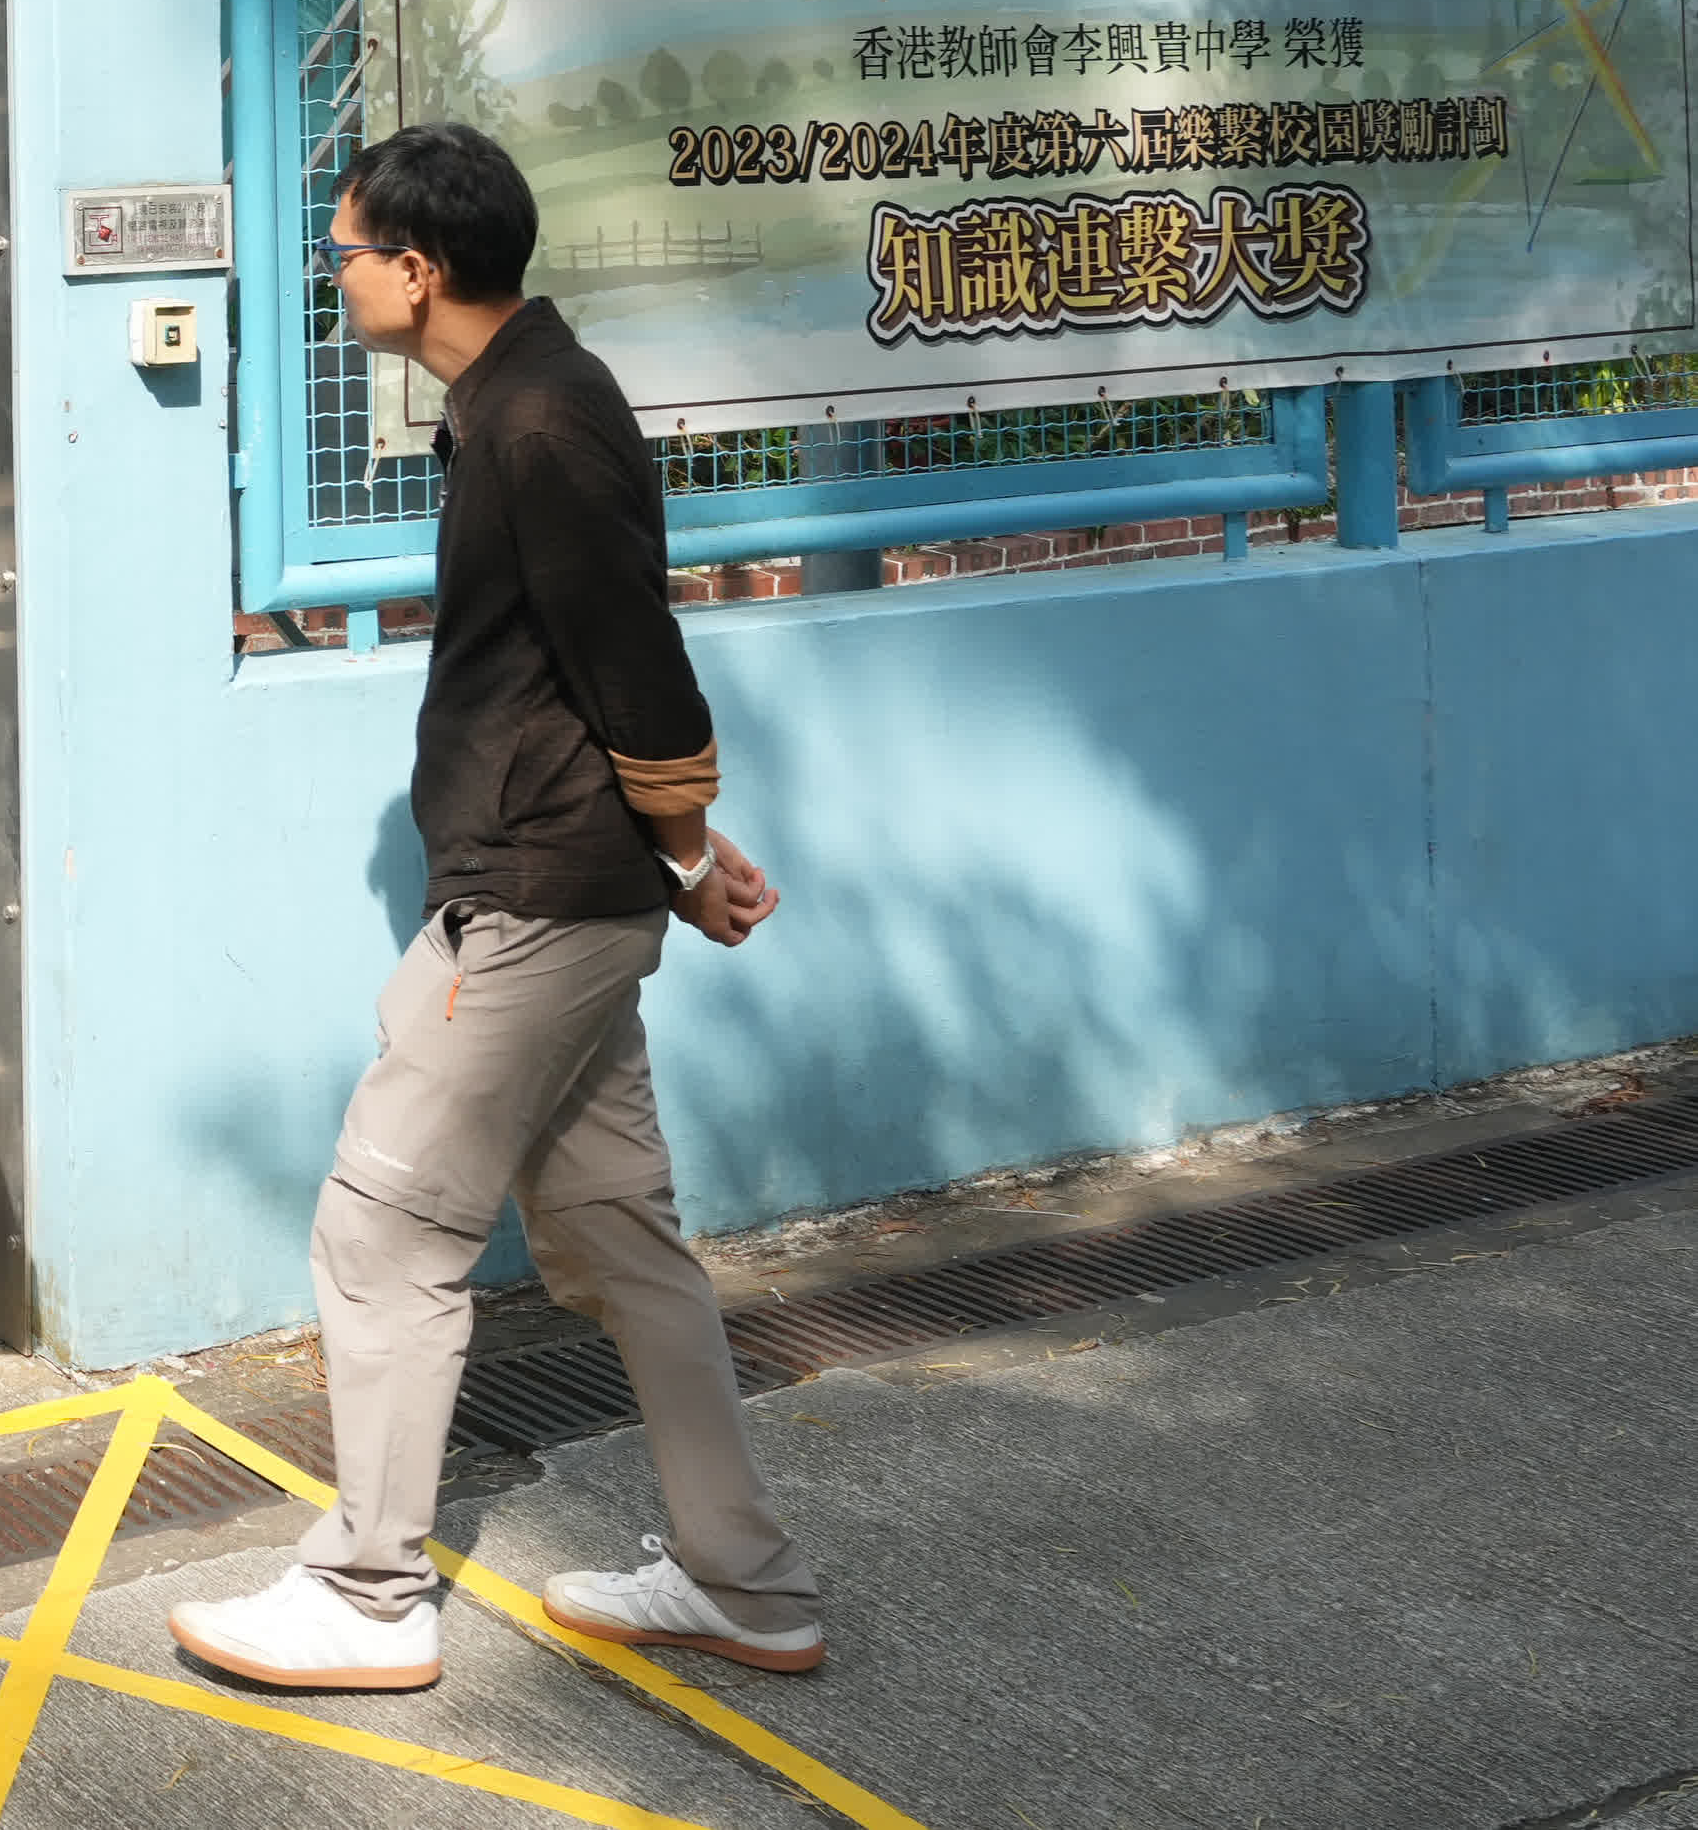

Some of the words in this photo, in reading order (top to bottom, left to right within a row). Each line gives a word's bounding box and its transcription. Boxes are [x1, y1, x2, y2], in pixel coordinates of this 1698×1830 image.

[851, 18, 1272, 82] 香港教師會李興貴中學
[1283, 15, 1366, 73] 榮獲
[877, 189, 1360, 330] 知識連繫大獎
